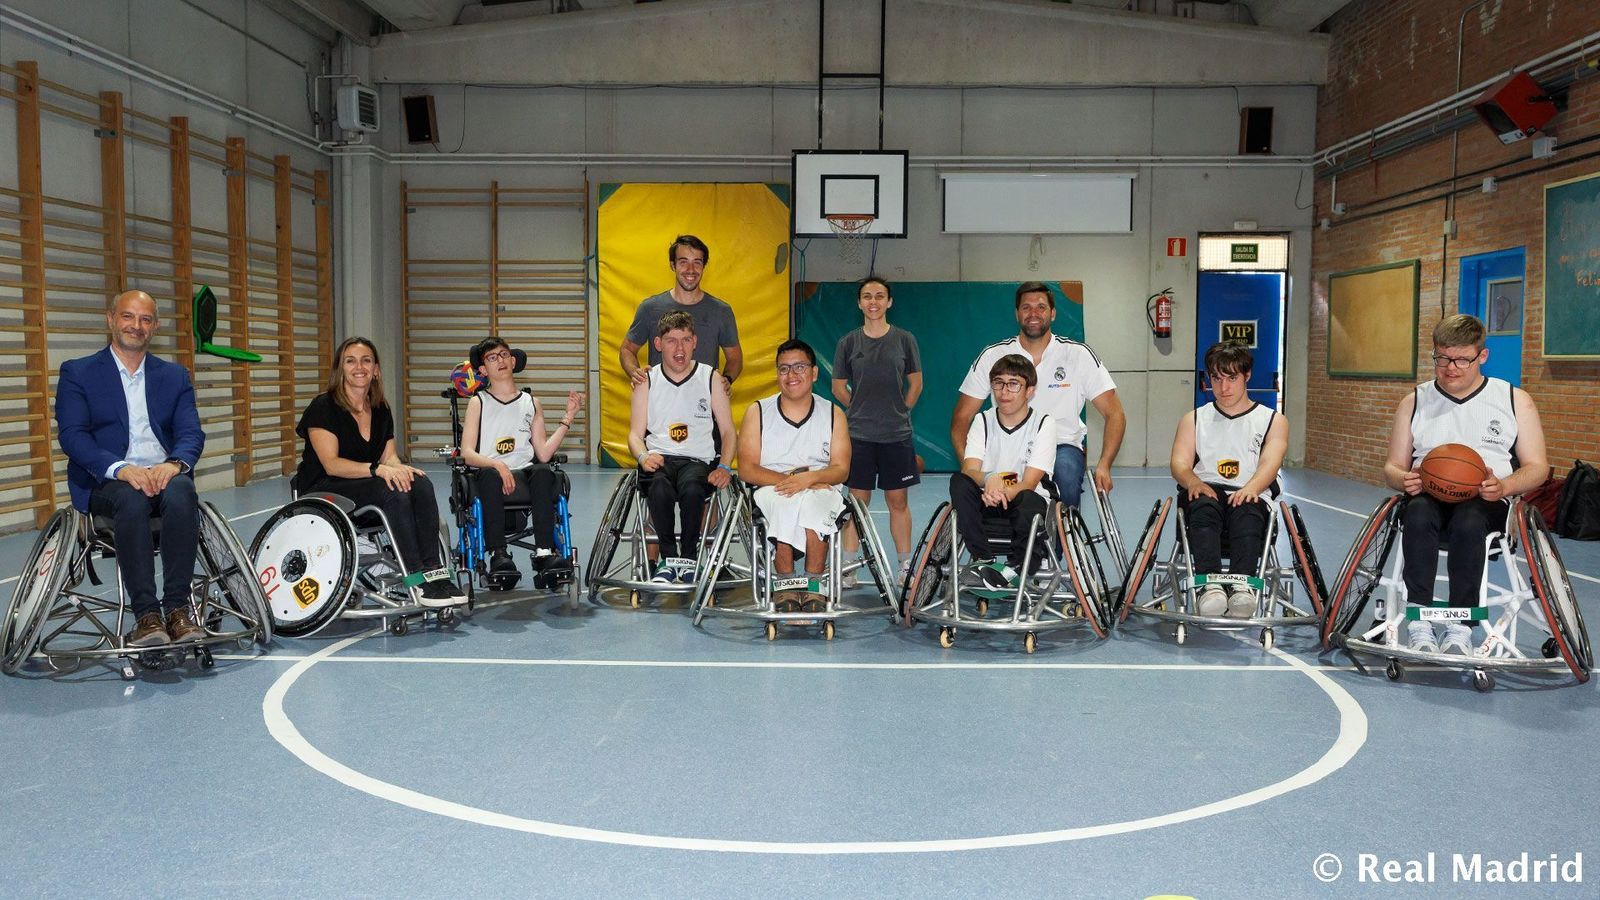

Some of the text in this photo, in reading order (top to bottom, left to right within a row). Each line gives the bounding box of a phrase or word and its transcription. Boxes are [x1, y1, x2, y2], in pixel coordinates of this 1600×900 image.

[1226, 326, 1252, 338] VIP
[671, 429, 687, 441] ups
[497, 442, 514, 454] ups
[1219, 465, 1238, 476] ups
[1427, 480, 1473, 498] SPALDING
[782, 579, 808, 587] SIGNUS
[1218, 574, 1247, 582] SIGNUS
[298, 579, 317, 605] ups
[1433, 610, 1469, 618] SGNUS
